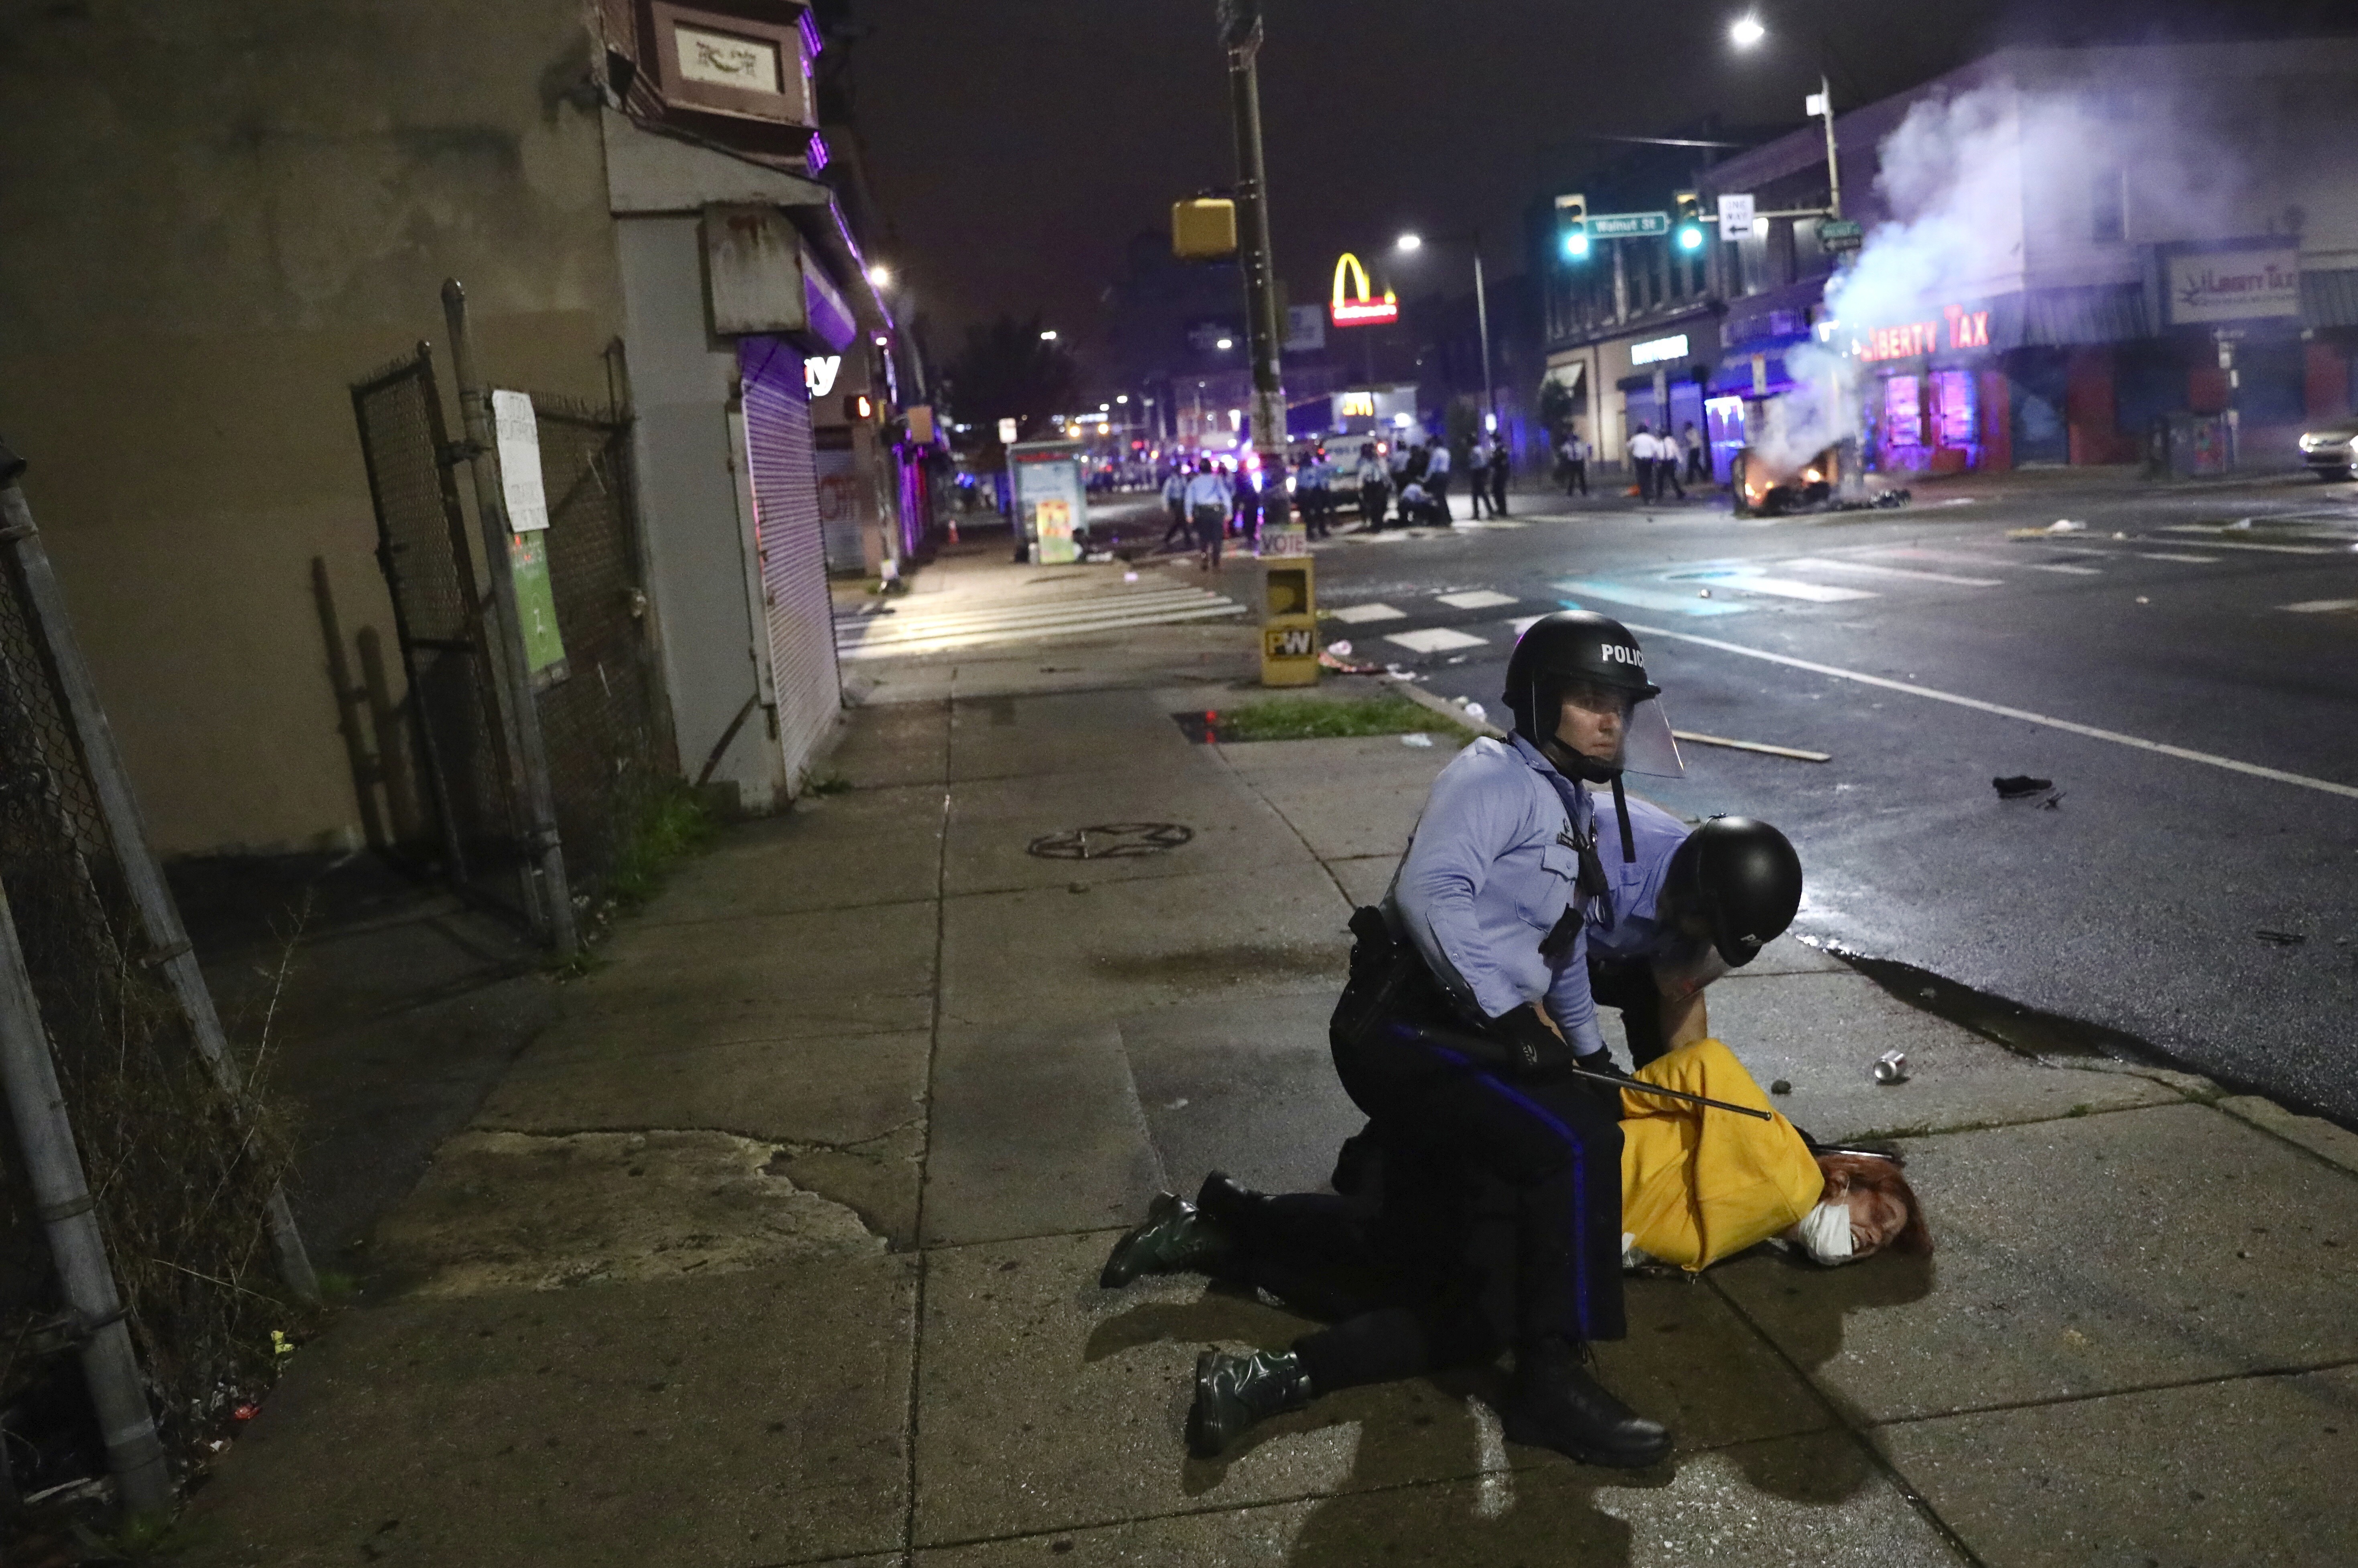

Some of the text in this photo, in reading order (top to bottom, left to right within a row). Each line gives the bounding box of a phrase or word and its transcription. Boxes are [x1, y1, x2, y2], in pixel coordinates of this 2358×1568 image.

[1725, 200, 1746, 210] ONE
[1596, 218, 1656, 233] Walnut St
[1944, 304, 1989, 349] TAX
[1260, 534, 1303, 552] VOTE
[1601, 644, 1645, 669] POLIC
